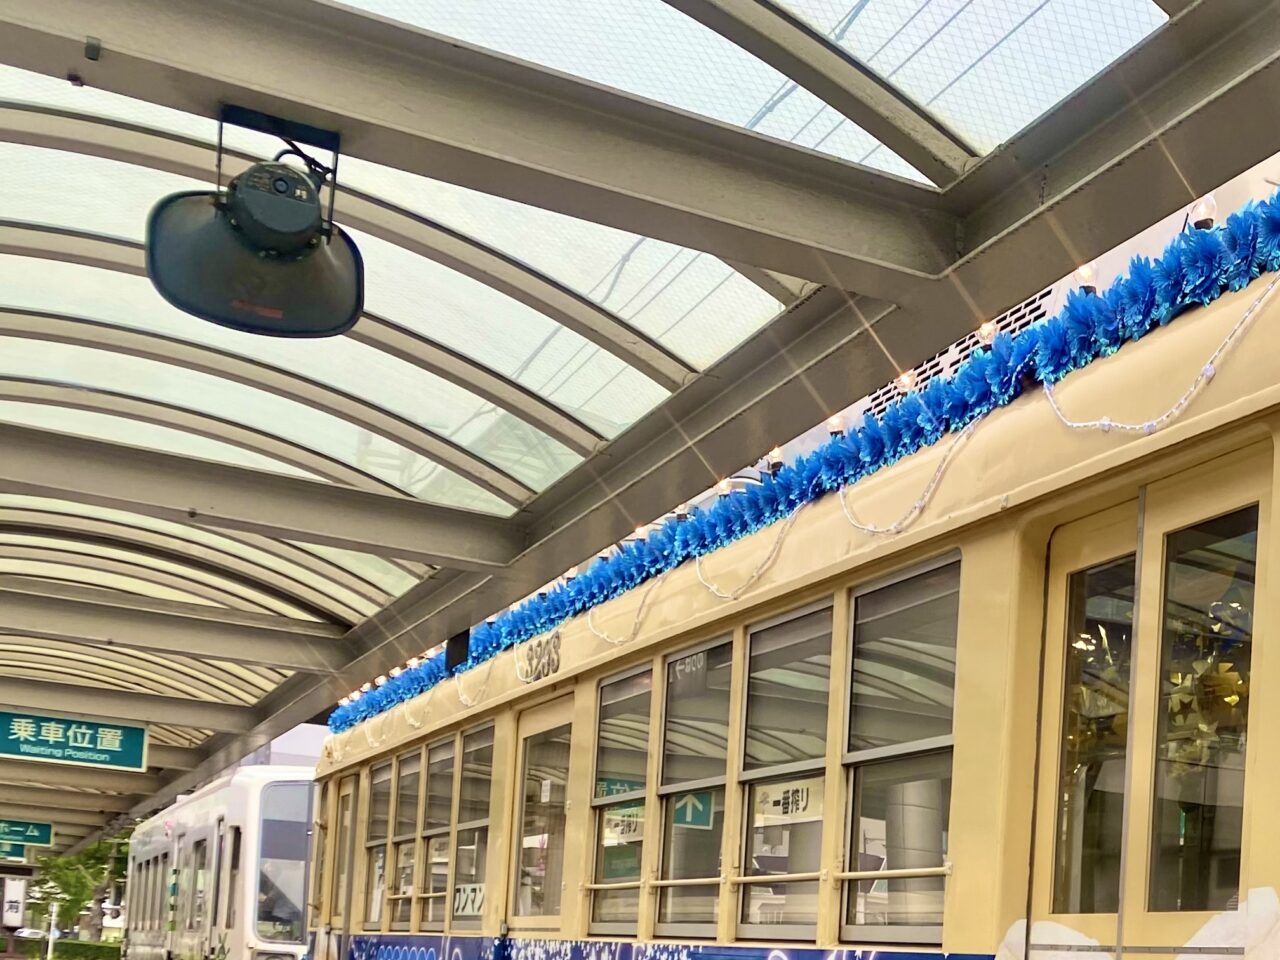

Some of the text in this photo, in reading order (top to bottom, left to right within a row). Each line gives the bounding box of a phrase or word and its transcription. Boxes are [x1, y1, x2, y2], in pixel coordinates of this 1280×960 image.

[8, 718, 123, 751] 乗車位置
[19, 743, 110, 761] Waiting Position
[772, 787, 809, 815] 一番搾り
